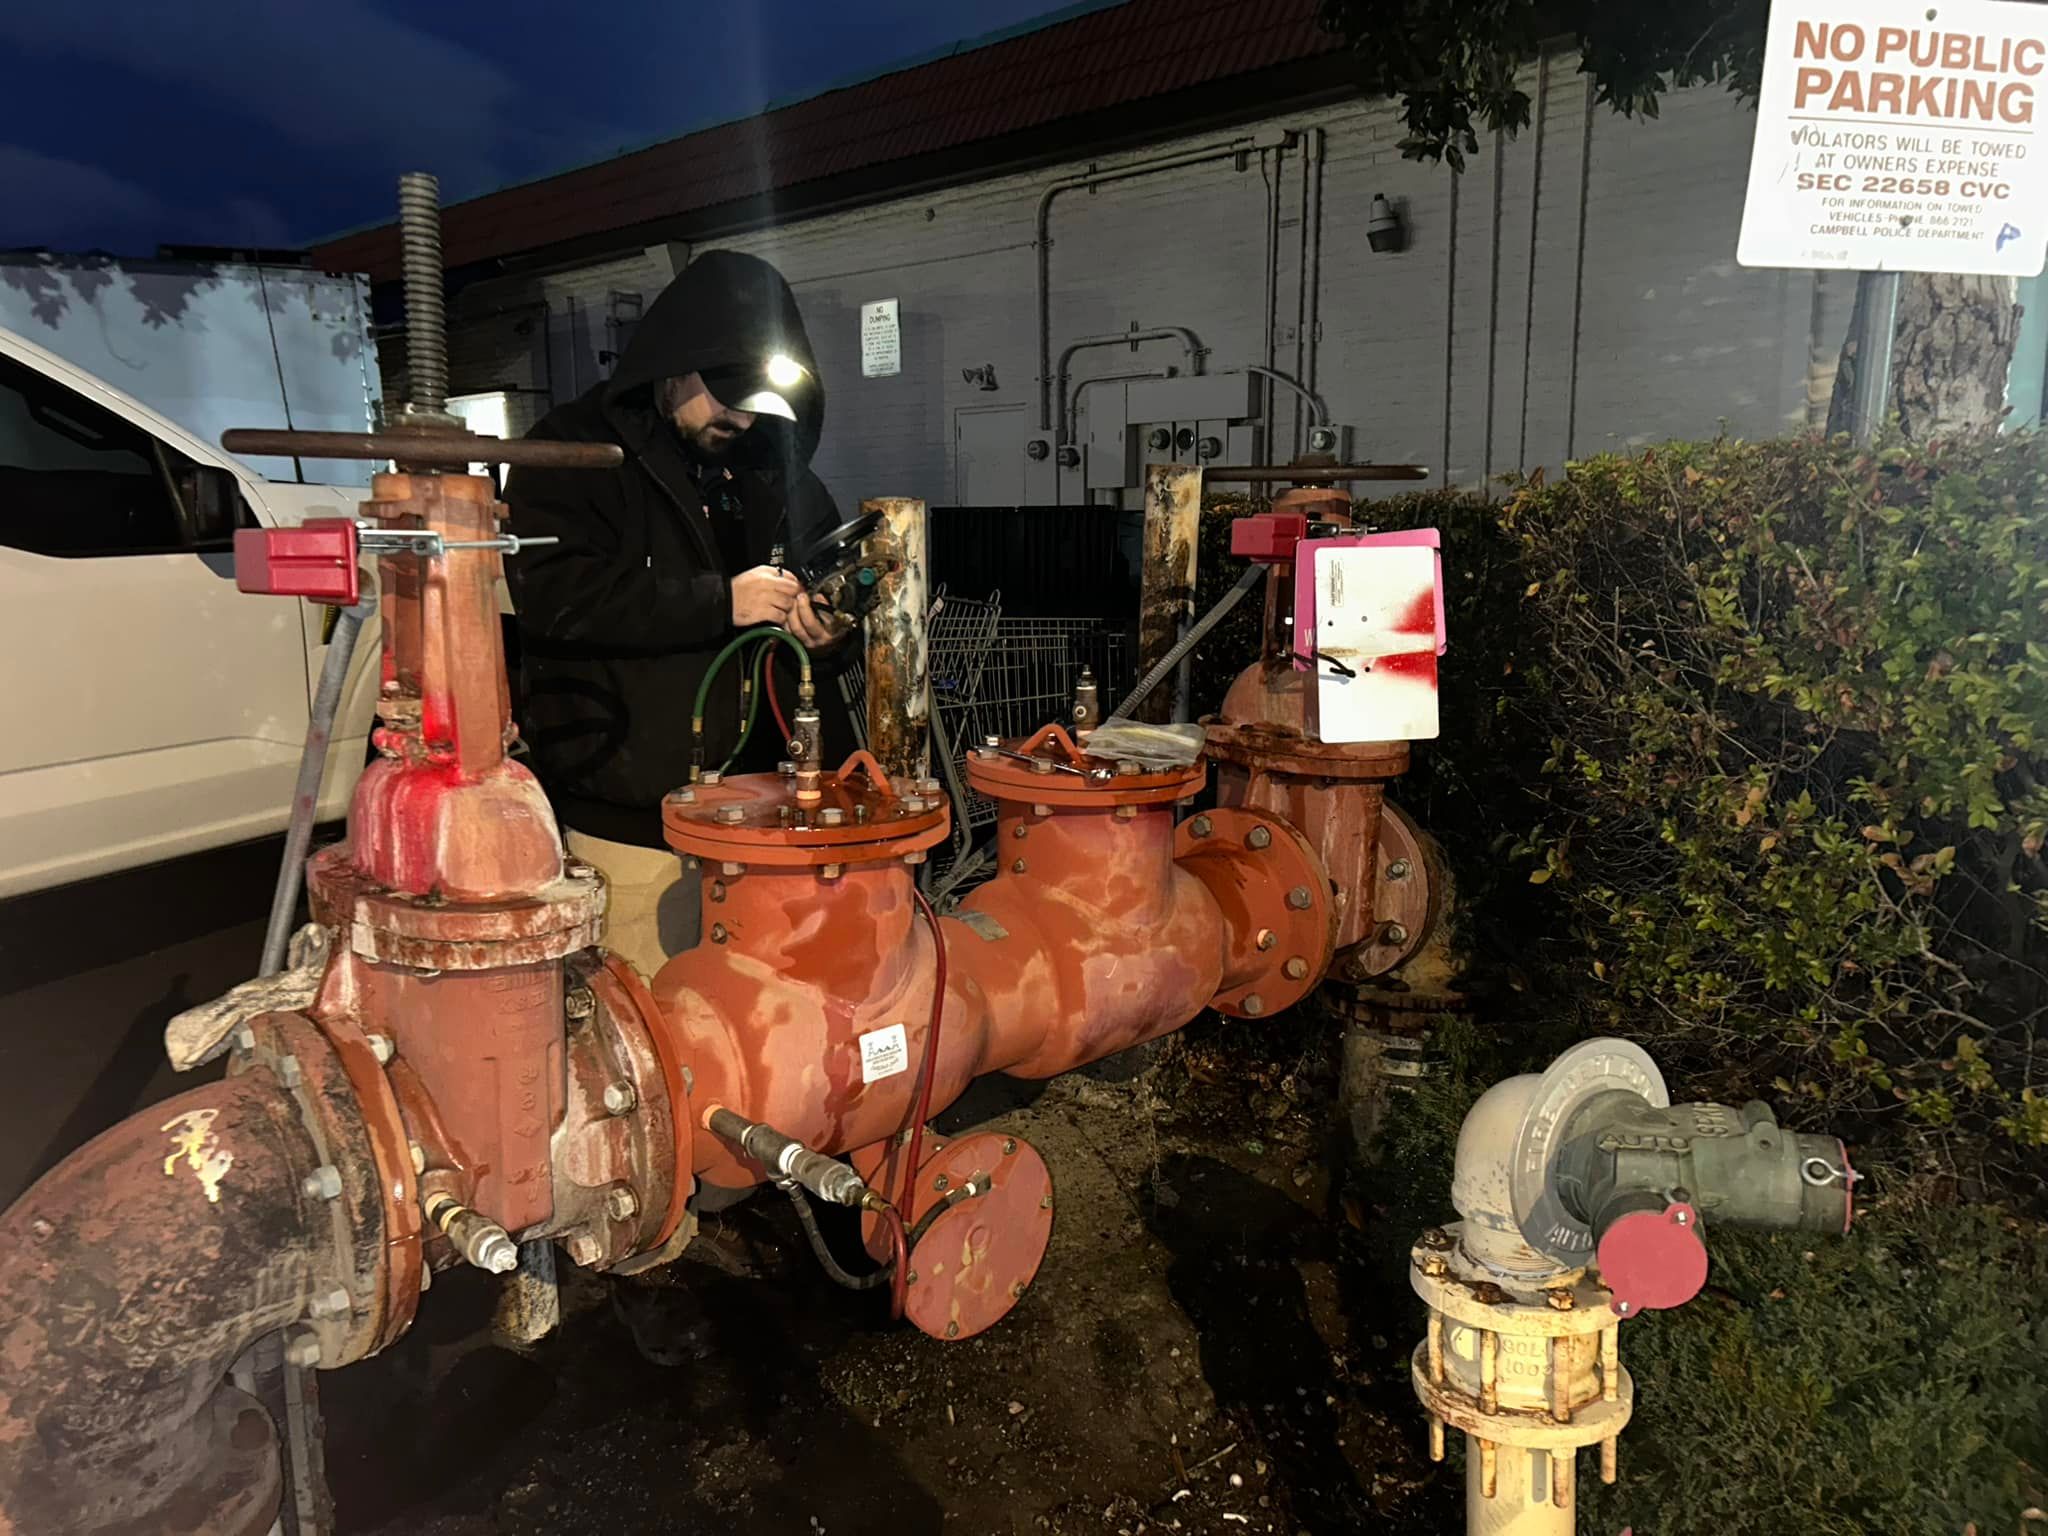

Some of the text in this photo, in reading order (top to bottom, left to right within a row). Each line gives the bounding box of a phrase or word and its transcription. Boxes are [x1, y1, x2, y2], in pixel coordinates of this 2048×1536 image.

[1793, 20, 2046, 76] NO PUBLIC
[1793, 66, 2035, 124] PARKING
[1791, 126, 2026, 160] VIOLATORS WILL BE TOWED
[1815, 152, 1999, 178] AT OWNERS EXPENSE
[1797, 172, 2010, 200] SEC 22658 CVC
[1821, 196, 1984, 214] FOR INFORMATION ON TOWED
[1810, 223, 1985, 241] CAMPBELL POLICE DEPARTMENT
[1598, 1134, 1689, 1151] AUTO
